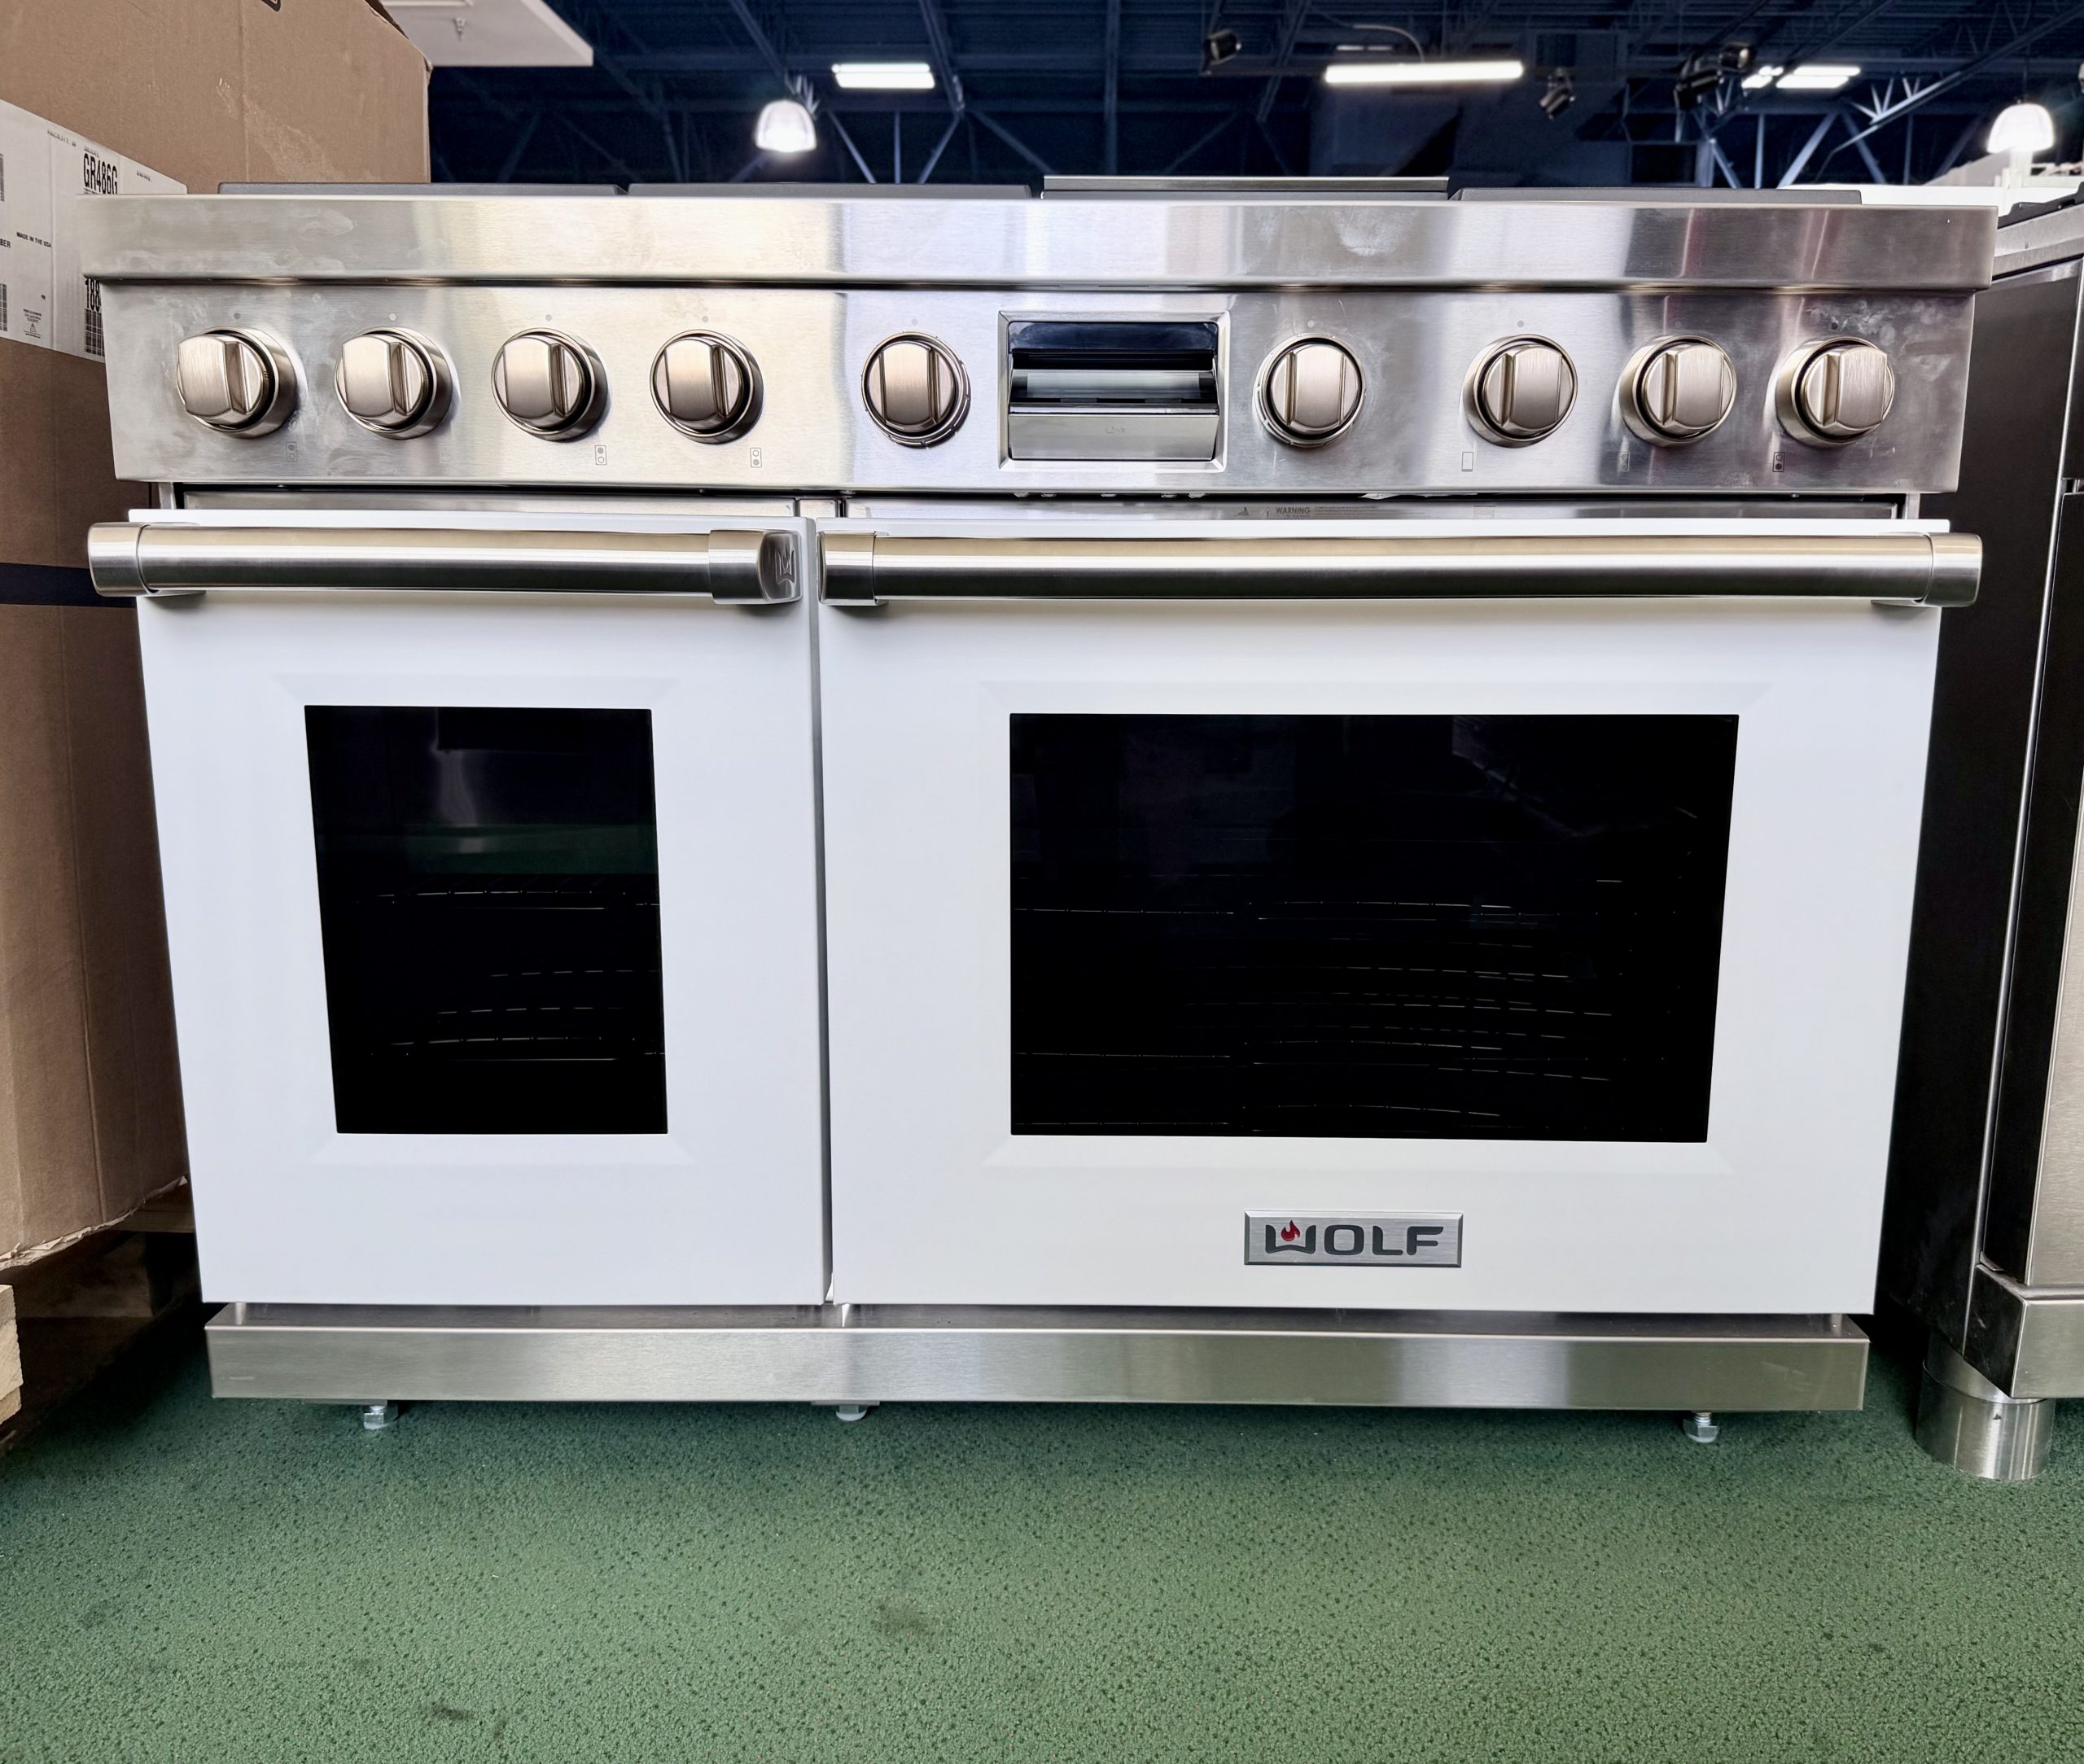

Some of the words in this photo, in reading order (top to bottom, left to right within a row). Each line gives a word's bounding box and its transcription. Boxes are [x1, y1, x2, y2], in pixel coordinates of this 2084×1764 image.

[84, 153, 118, 194] GR486G
[16, 231, 28, 241] MADE
[35, 237, 43, 245] THE
[43, 240, 52, 248] USA
[85, 278, 101, 312] 188
[1276, 506, 1311, 515] WARNING
[1265, 1223, 1444, 1256] WOLF
